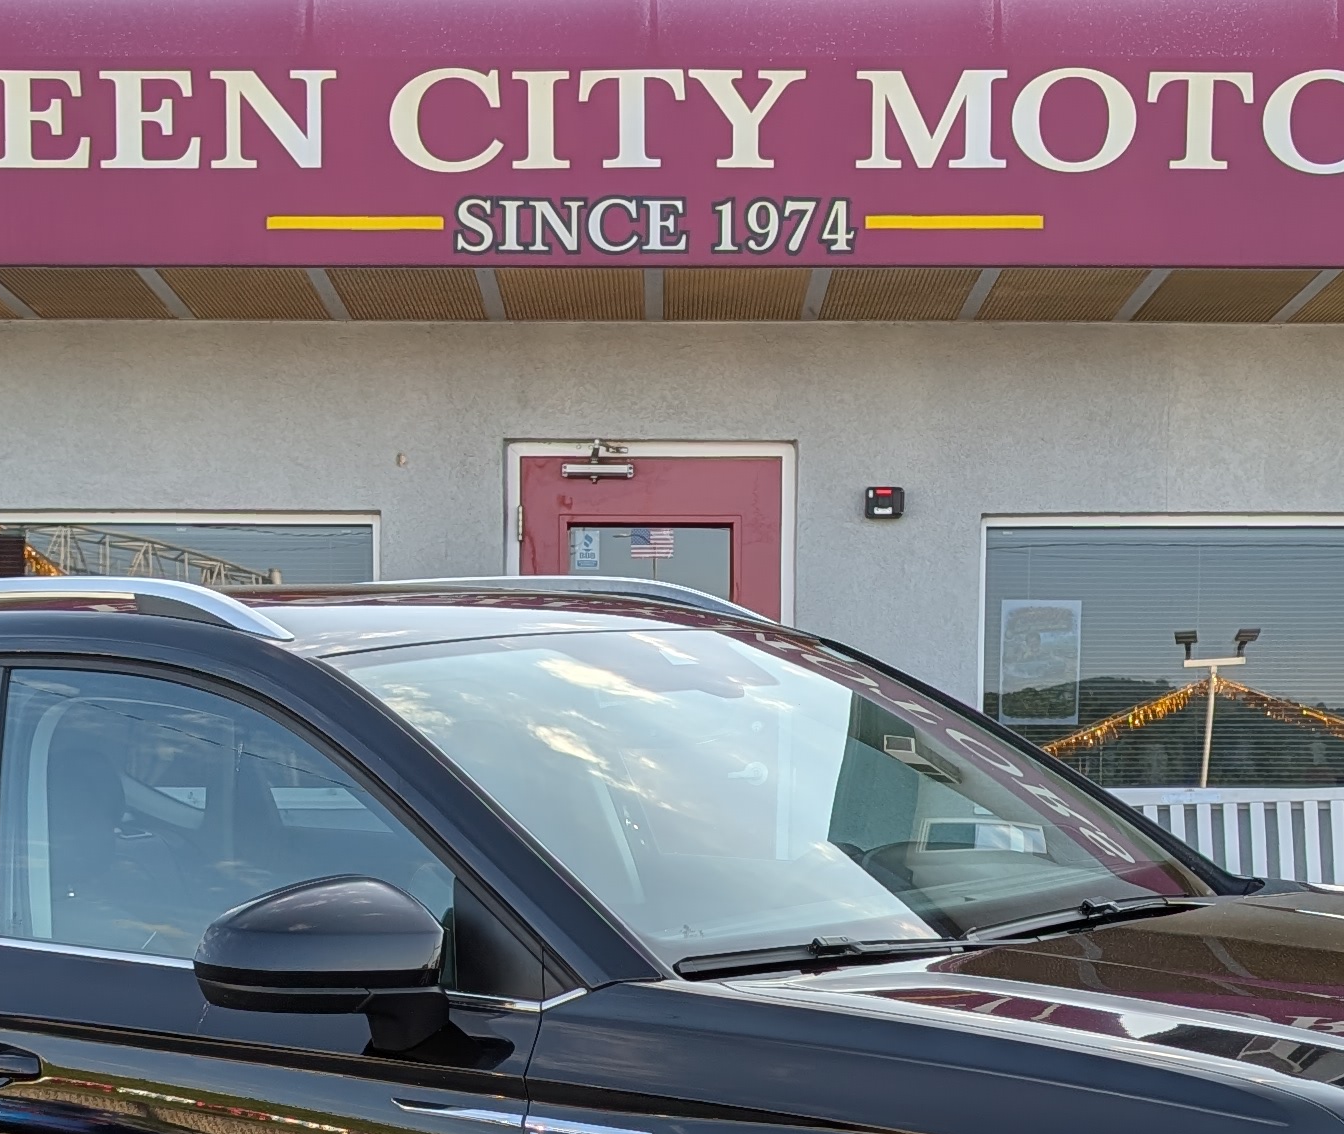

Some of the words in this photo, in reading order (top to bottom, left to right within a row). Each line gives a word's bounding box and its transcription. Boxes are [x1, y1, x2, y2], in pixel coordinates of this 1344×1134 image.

[388, 67, 807, 174] CITY
[455, 198, 687, 254] SINCE
[712, 198, 856, 254] 1974
